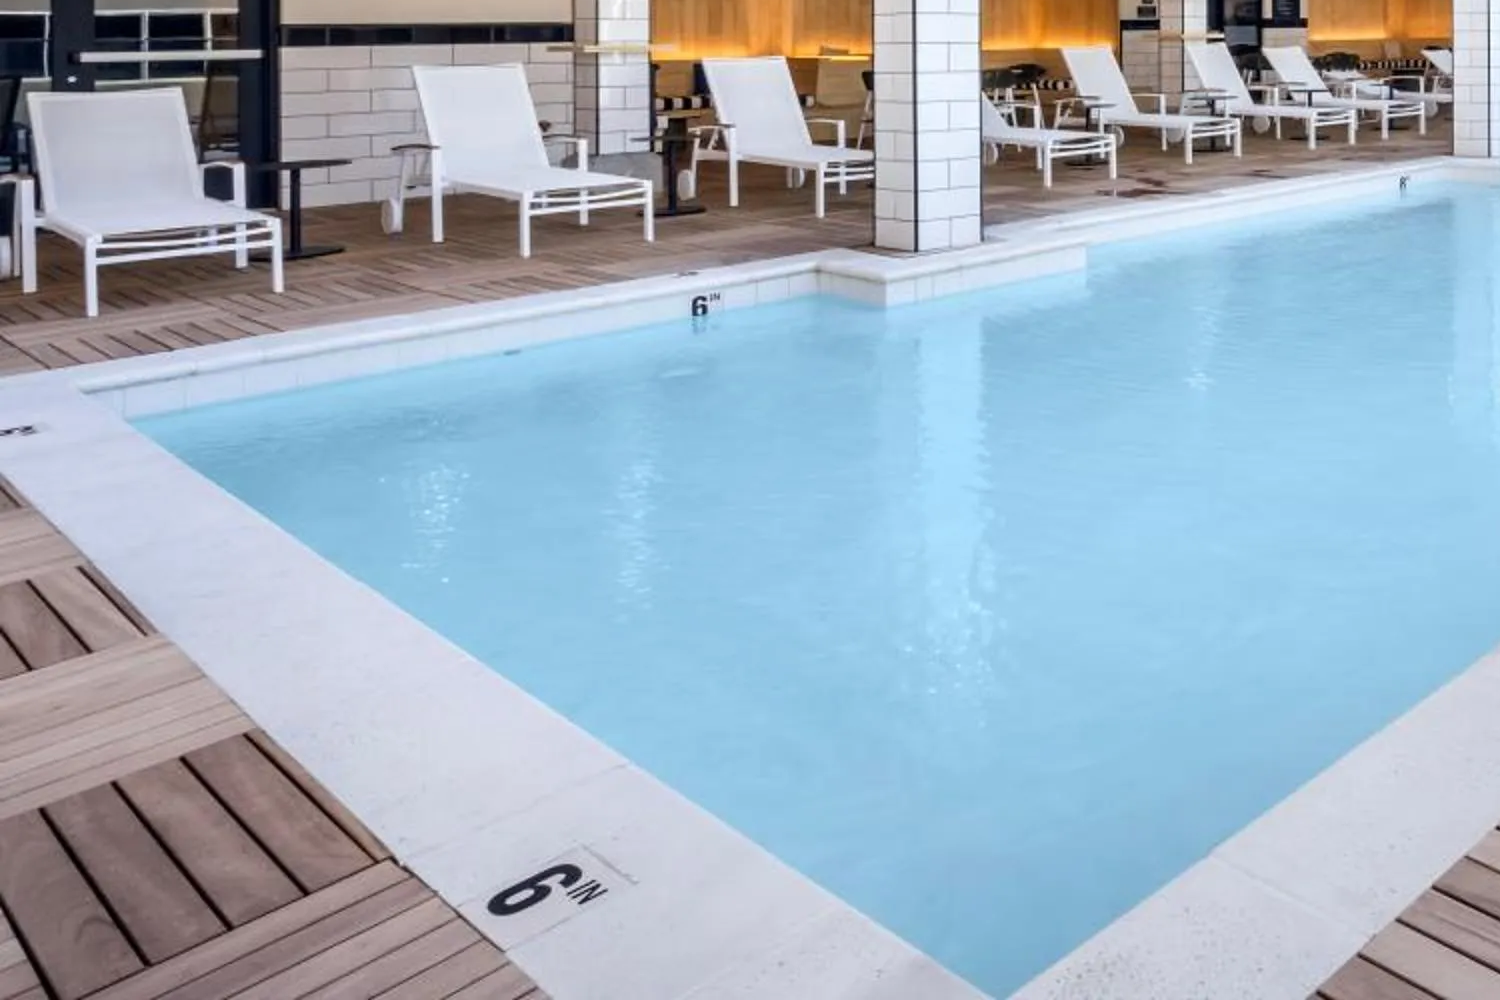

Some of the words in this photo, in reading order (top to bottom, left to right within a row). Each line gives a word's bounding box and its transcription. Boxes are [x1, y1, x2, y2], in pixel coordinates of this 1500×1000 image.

[692, 295, 708, 316] 6
[487, 863, 582, 917] 6
[566, 879, 609, 905] IN
